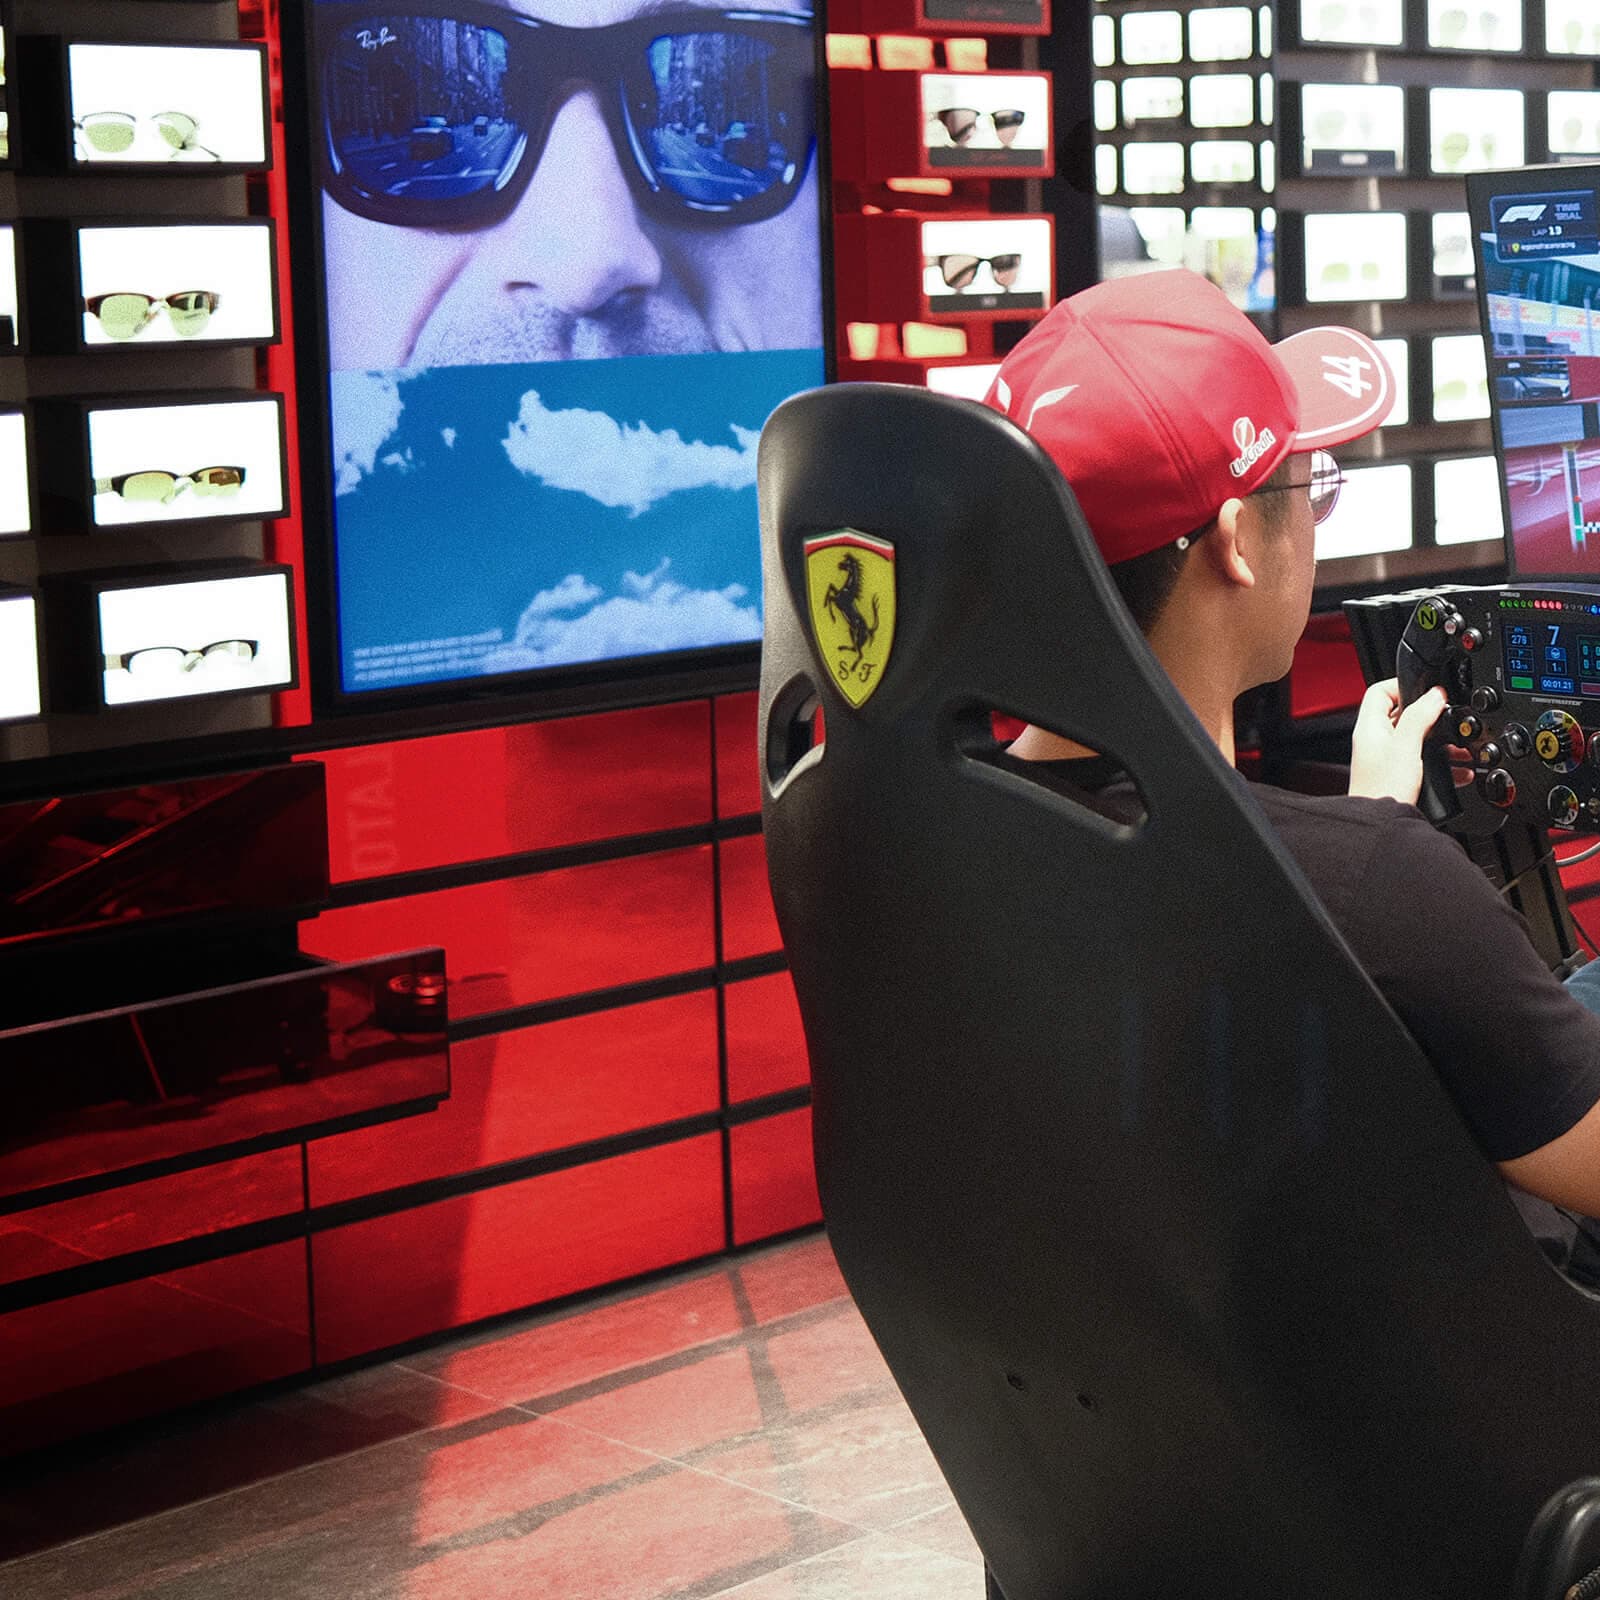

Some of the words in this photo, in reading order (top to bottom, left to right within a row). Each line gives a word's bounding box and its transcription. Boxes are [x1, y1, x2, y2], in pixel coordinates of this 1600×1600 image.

[1499, 204, 1547, 223] F1
[1532, 229, 1547, 237] LAP
[1548, 225, 1562, 236] 13
[1321, 355, 1372, 399] 44
[1230, 428, 1276, 477] UniCredit
[1420, 610, 1435, 626] N
[1547, 625, 1560, 646] 7
[837, 658, 850, 681] S
